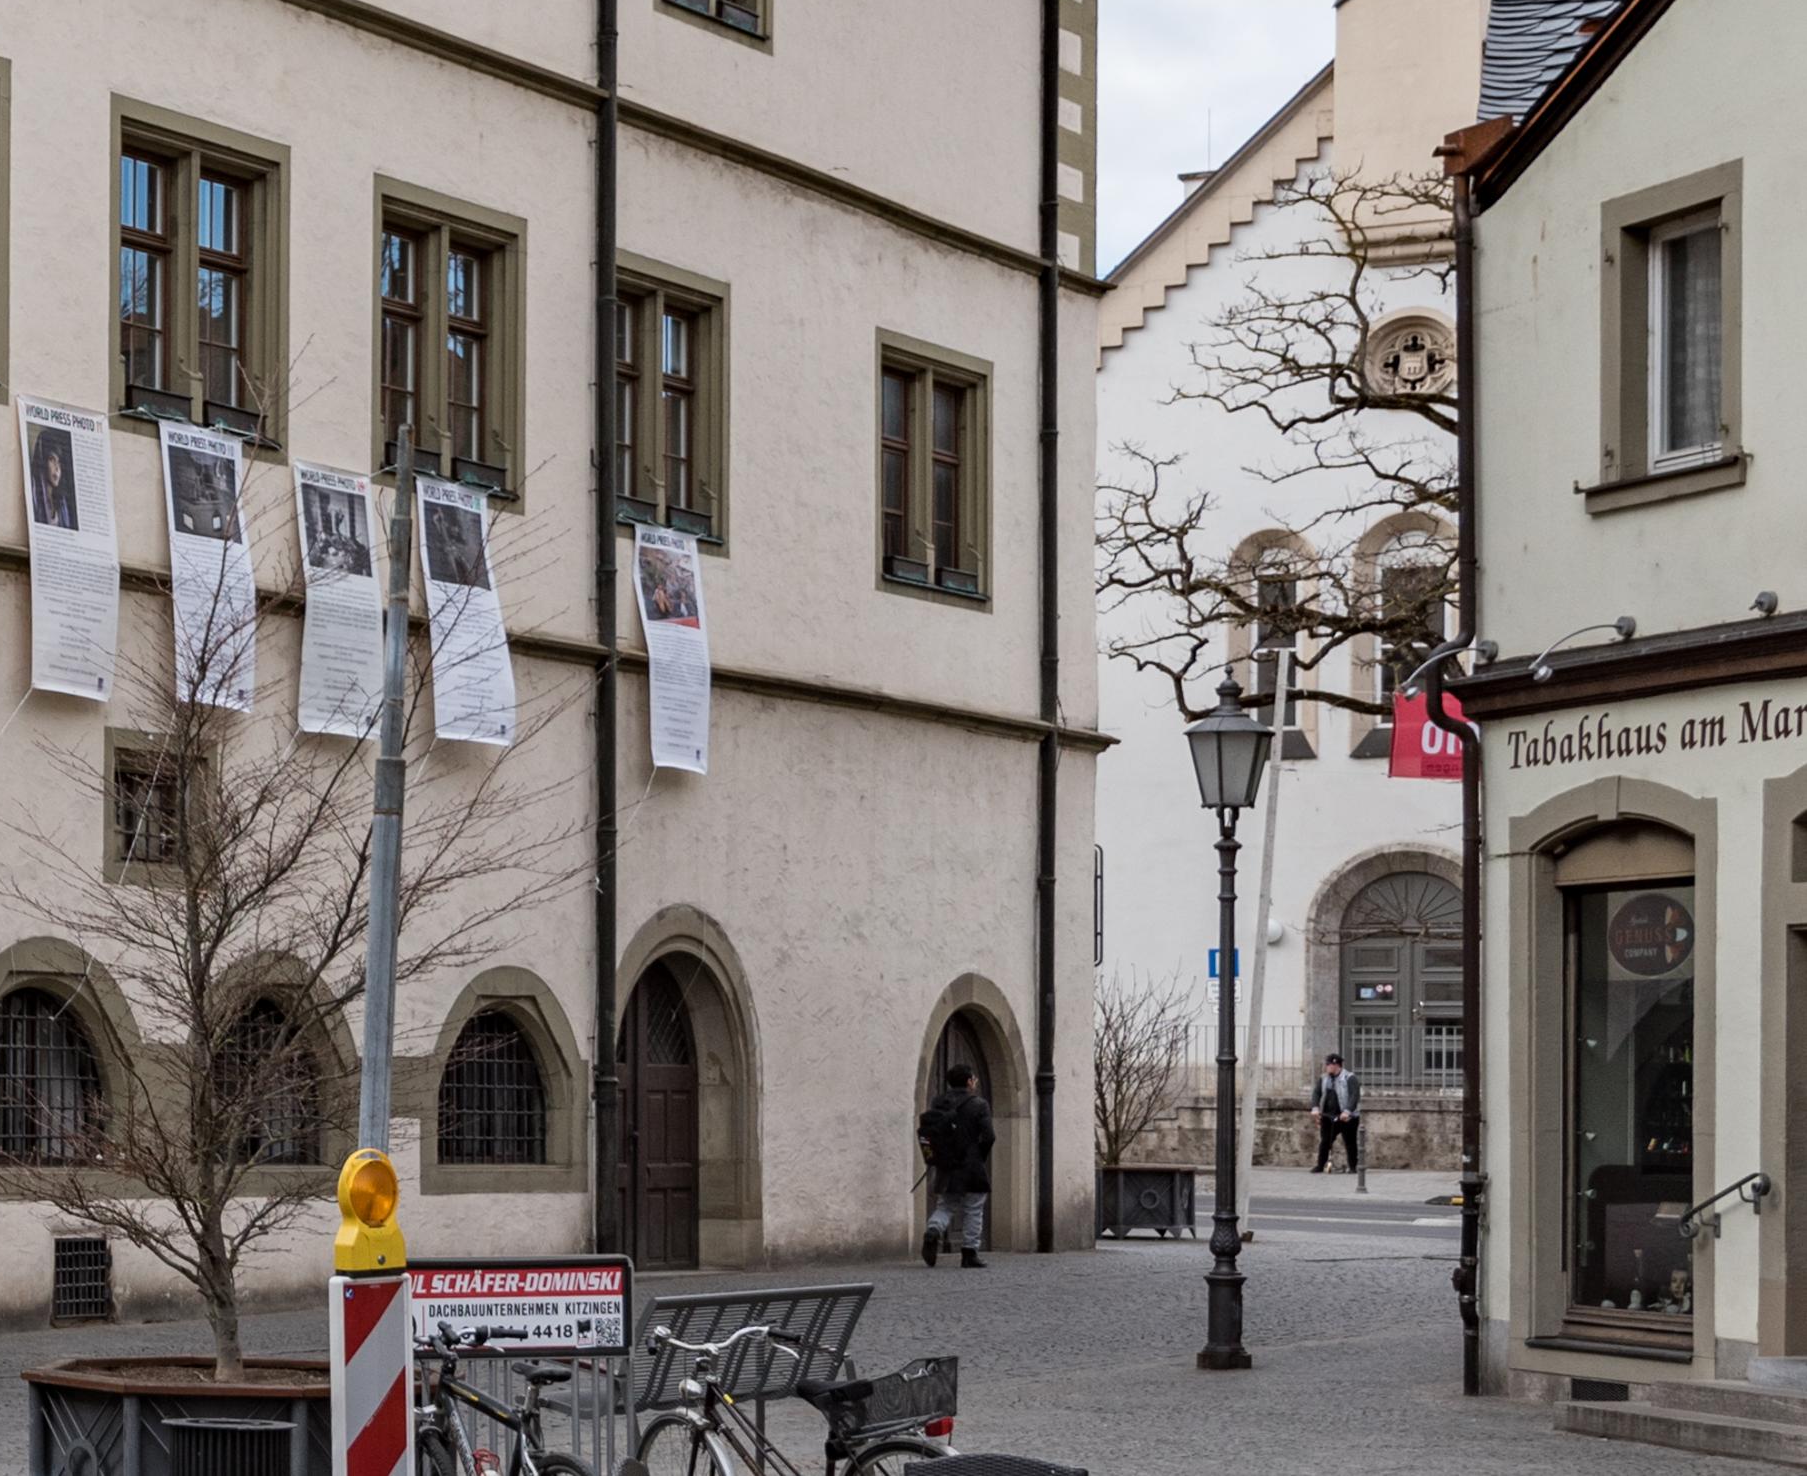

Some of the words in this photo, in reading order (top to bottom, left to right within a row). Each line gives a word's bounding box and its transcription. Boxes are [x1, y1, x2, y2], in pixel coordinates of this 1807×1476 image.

[25, 404, 49, 420] WORLD
[50, 410, 71, 426] PRESS
[72, 414, 95, 432] PHOTO
[168, 432, 190, 446] WORLD
[190, 435, 207, 450] PRESS
[1507, 712, 1667, 770] Tabakhaus
[1680, 715, 1726, 750] am
[430, 1269, 623, 1294] SCHÄFER-DOMINSKI
[429, 1302, 559, 1317] DACHBAUUNTERNEHMEN
[565, 1301, 621, 1315] KITZINGEN
[532, 1325, 574, 1339] 4418
